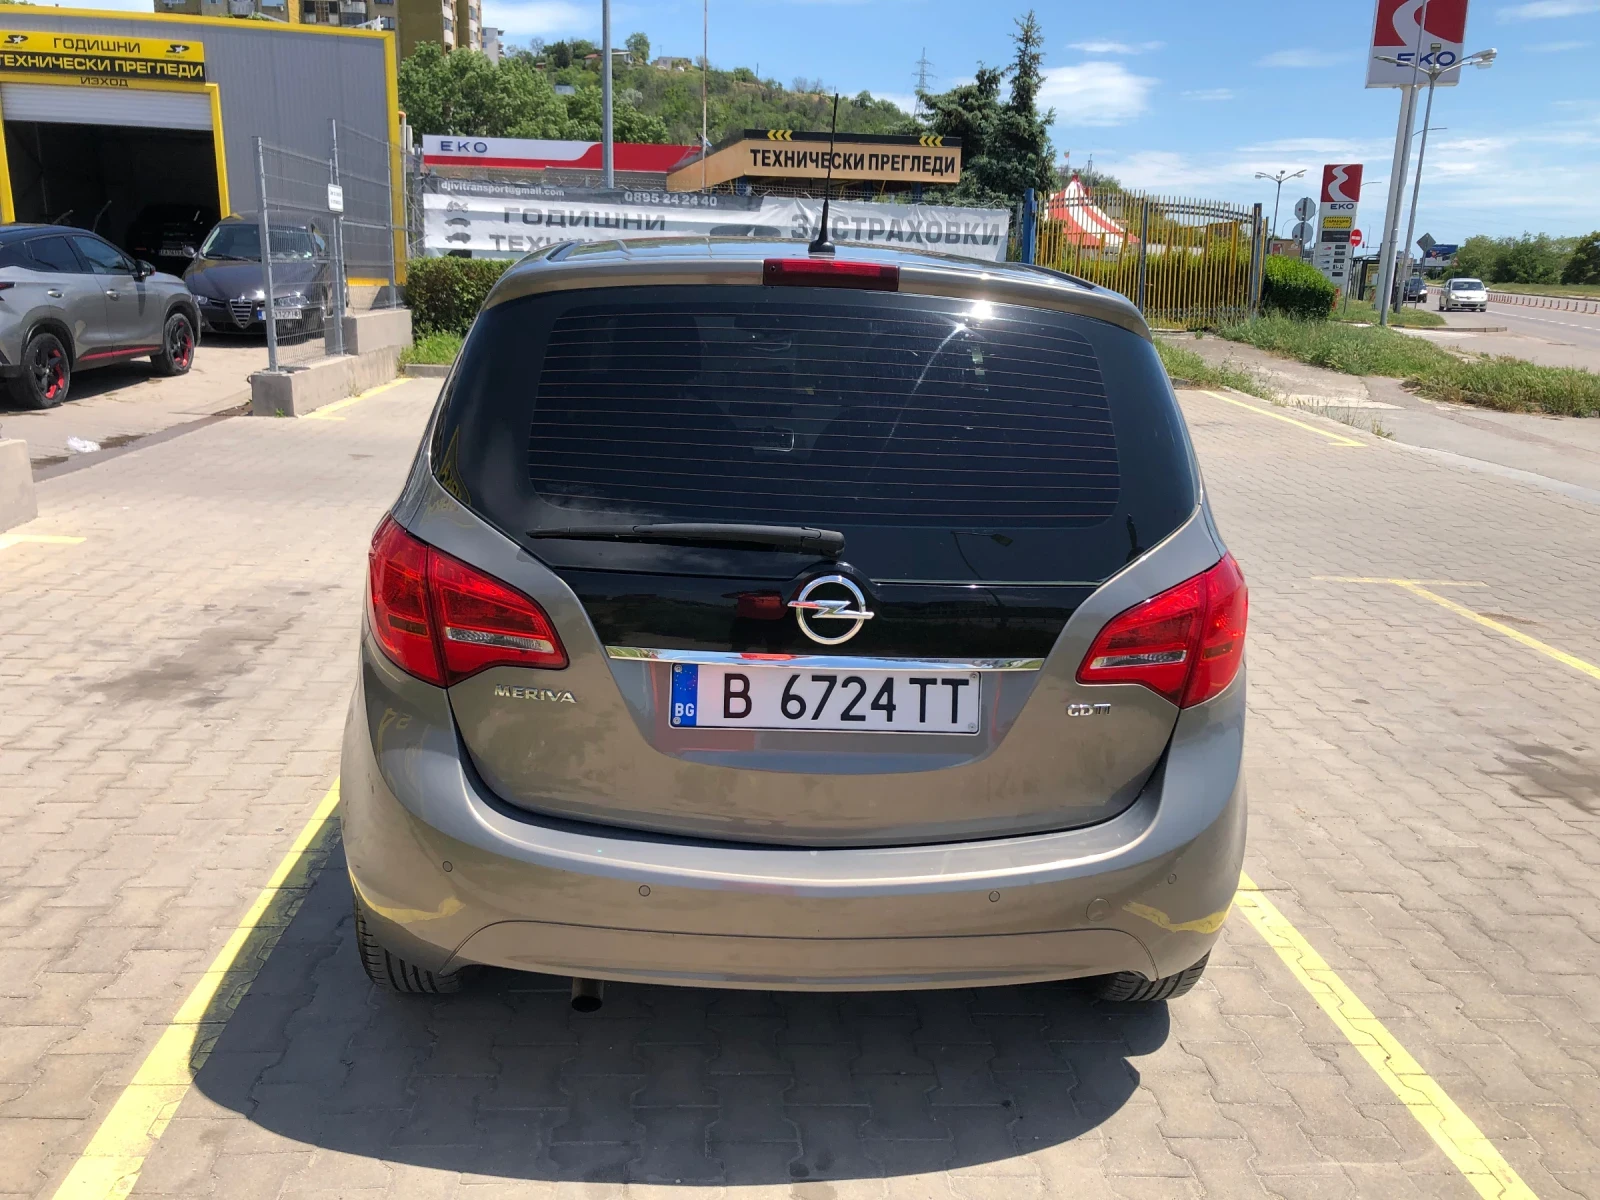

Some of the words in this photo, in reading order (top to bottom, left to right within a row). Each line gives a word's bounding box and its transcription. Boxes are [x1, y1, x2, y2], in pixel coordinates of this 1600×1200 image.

[53, 37, 141, 53] ГОДИШНИ
[0, 53, 111, 72] ТЕХНИЧЕСКИ
[115, 59, 203, 78] ПРЕГЛЕДИ
[1396, 50, 1456, 67] EKO
[79, 76, 129, 87] ИЗХОД
[440, 140, 488, 154] EKO
[751, 149, 865, 171] ТЕХНИЧЕСКИ
[868, 153, 955, 177] ПРЕГЛЕДИ
[624, 191, 660, 204] 0895
[662, 193, 680, 205] 24
[681, 194, 699, 206] 24
[700, 195, 718, 207] 40
[504, 207, 666, 231] ГОДИШНИ
[494, 684, 577, 704] MERIVA
[723, 673, 752, 719] B
[780, 674, 897, 723] 6724
[909, 678, 970, 724] TT
[674, 703, 695, 717] BG
